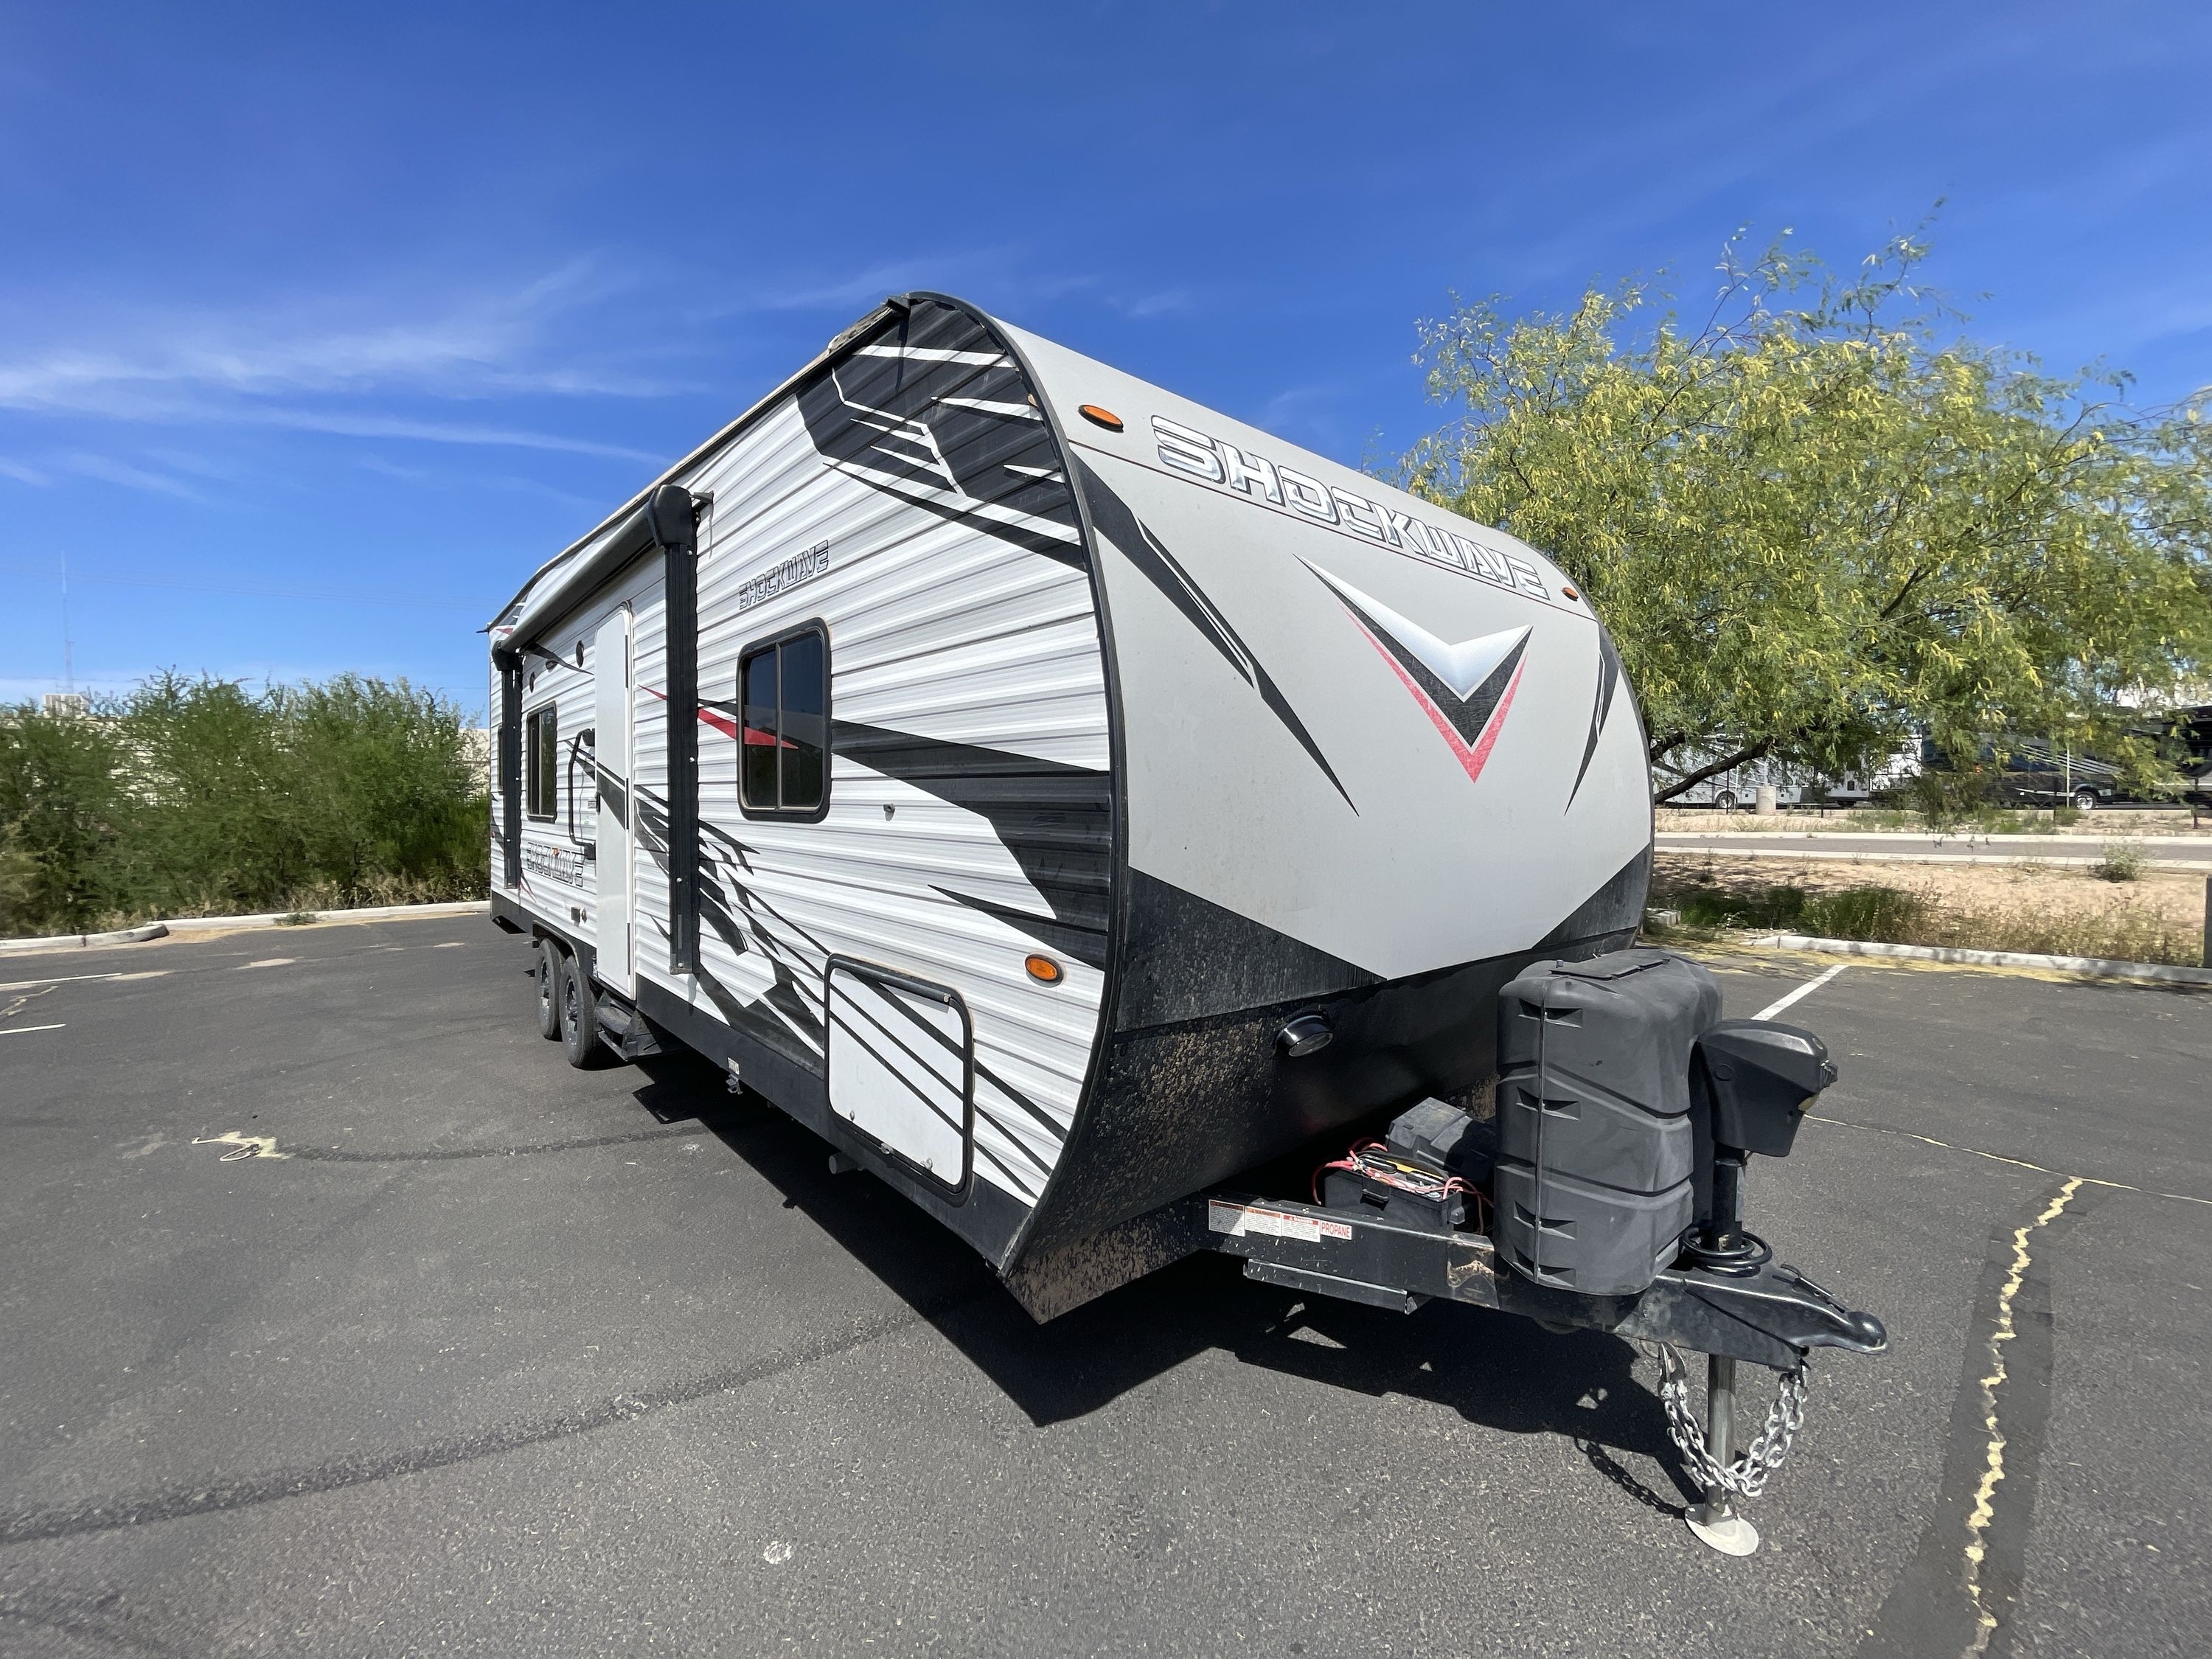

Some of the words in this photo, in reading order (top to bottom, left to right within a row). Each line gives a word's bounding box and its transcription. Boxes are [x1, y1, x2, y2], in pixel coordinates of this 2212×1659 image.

[1151, 414, 1551, 601] SHOCKWAVE
[739, 539, 829, 611] SHOCKWAVE
[1321, 1222, 1350, 1238] PROPANE
